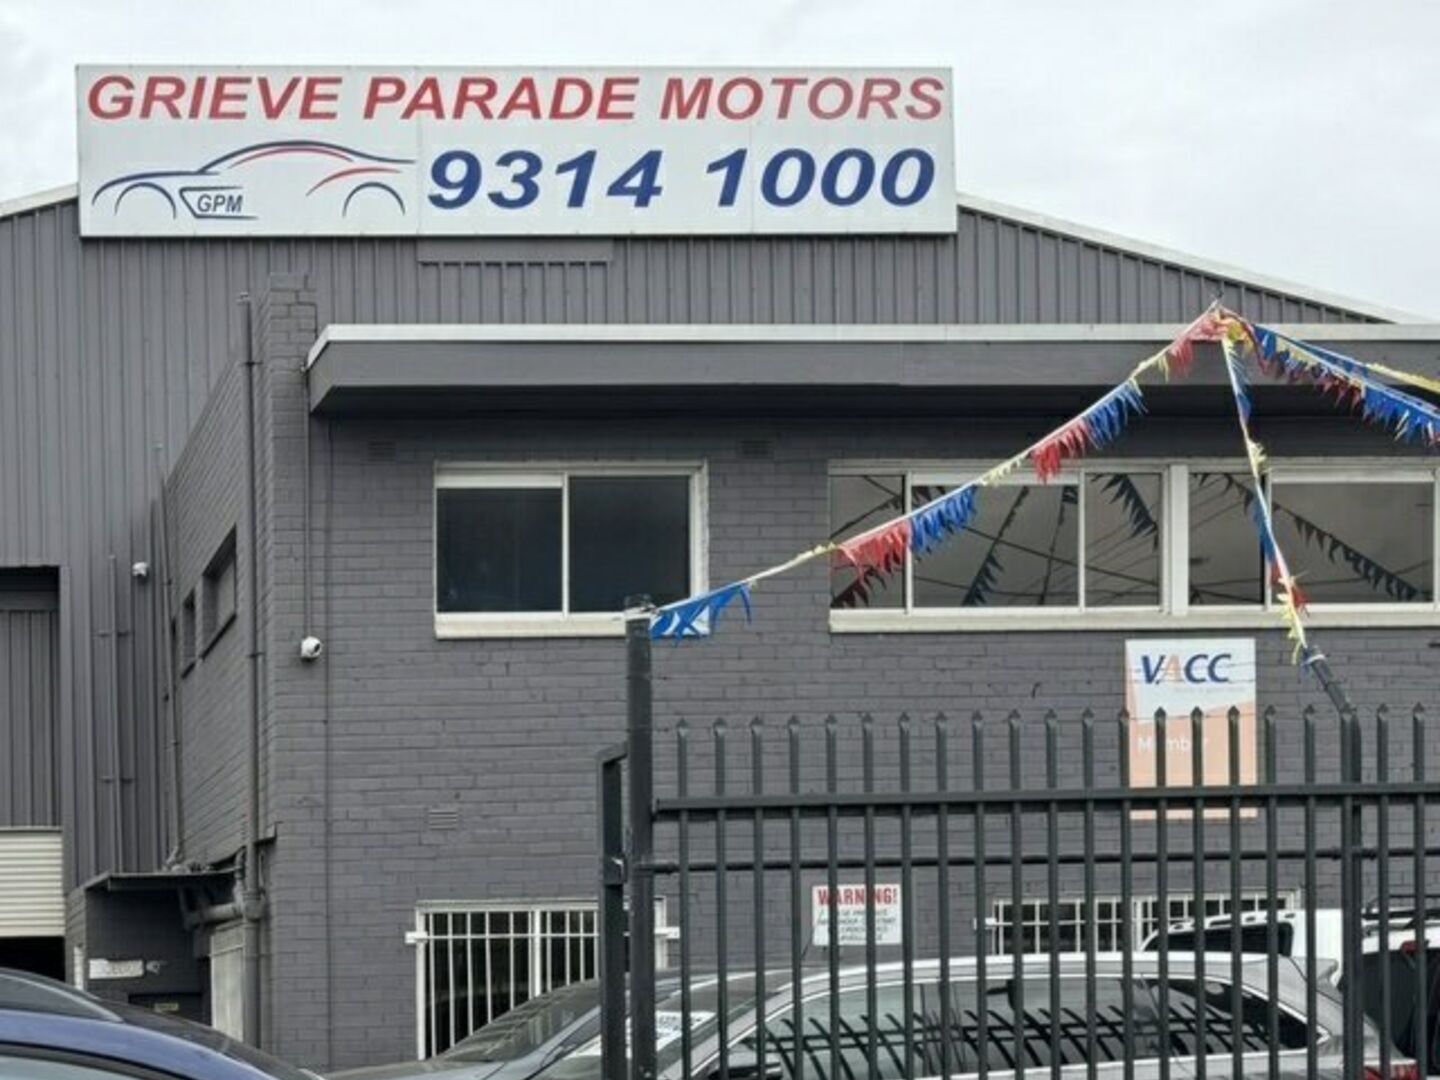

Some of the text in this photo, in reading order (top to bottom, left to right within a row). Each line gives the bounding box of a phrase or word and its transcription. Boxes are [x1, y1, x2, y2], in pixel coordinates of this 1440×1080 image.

[87, 76, 945, 121] GRIEVE PARADE MOTORS
[427, 148, 937, 210] 9314 1000
[196, 193, 244, 213] GPM
[1140, 653, 1232, 685] VACC
